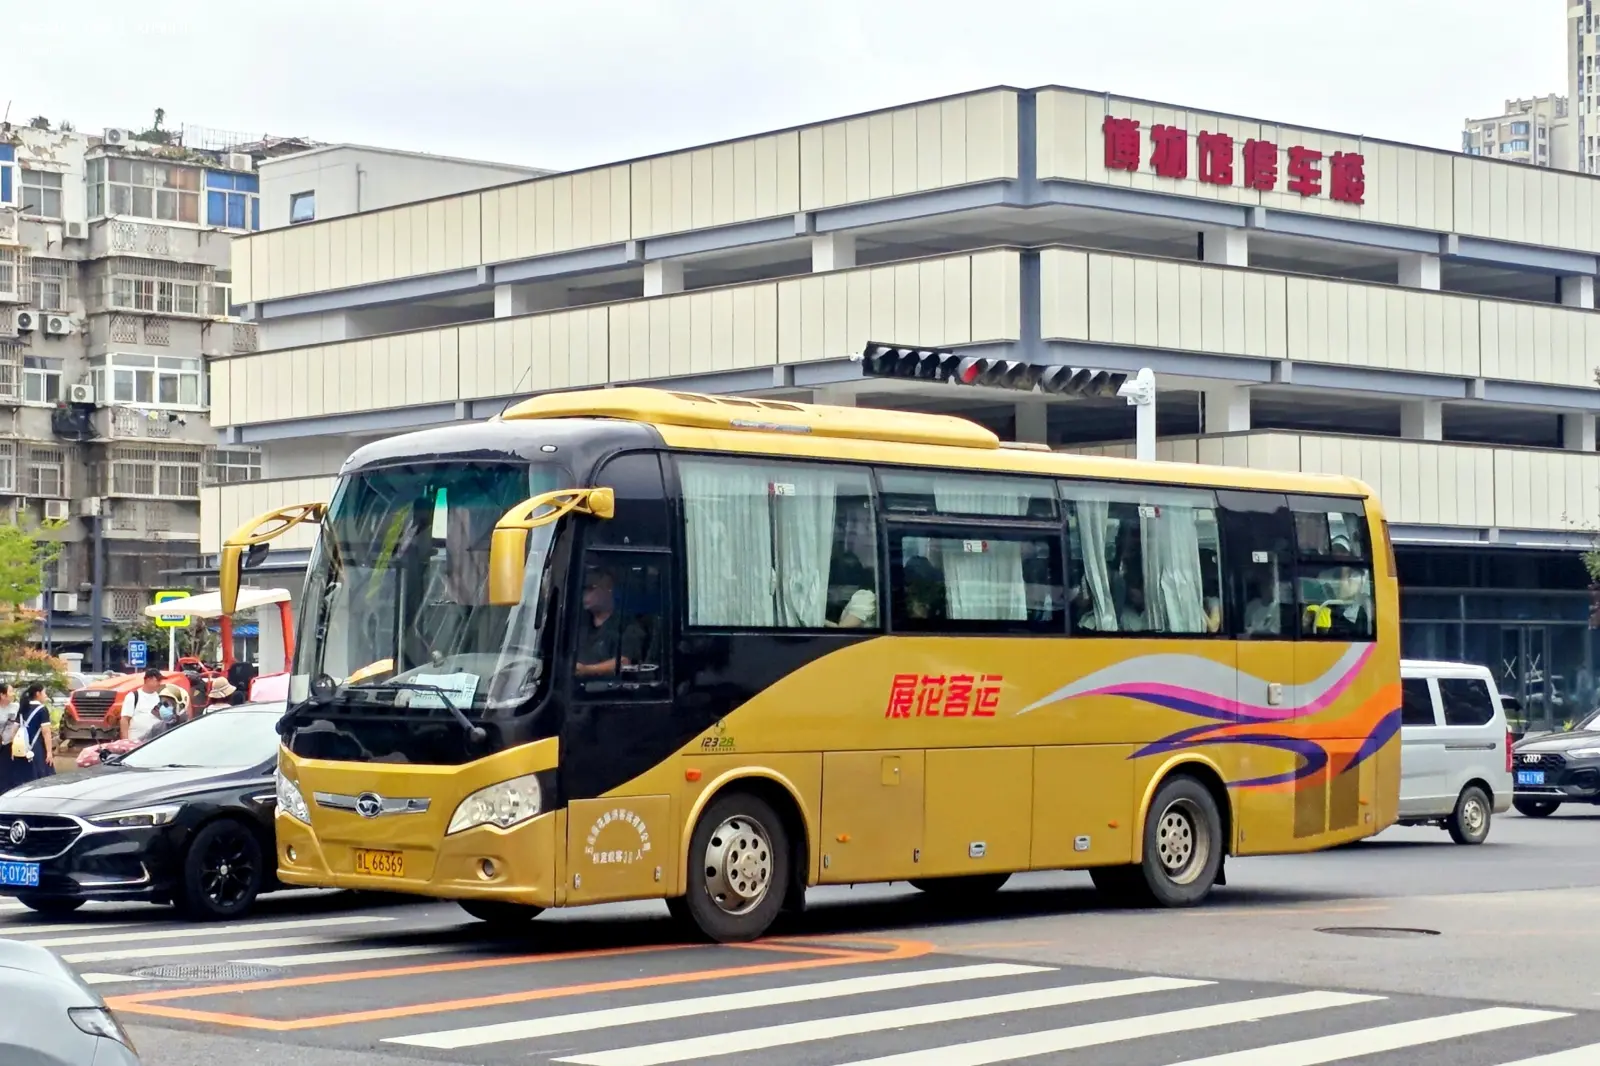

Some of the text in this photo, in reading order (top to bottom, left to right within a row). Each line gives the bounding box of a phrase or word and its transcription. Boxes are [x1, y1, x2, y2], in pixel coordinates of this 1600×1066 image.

[1102, 115, 1365, 204] 博物馆停车楼
[885, 674, 1003, 718] 展花客运
[0, 865, 38, 882] C0Y2H5
